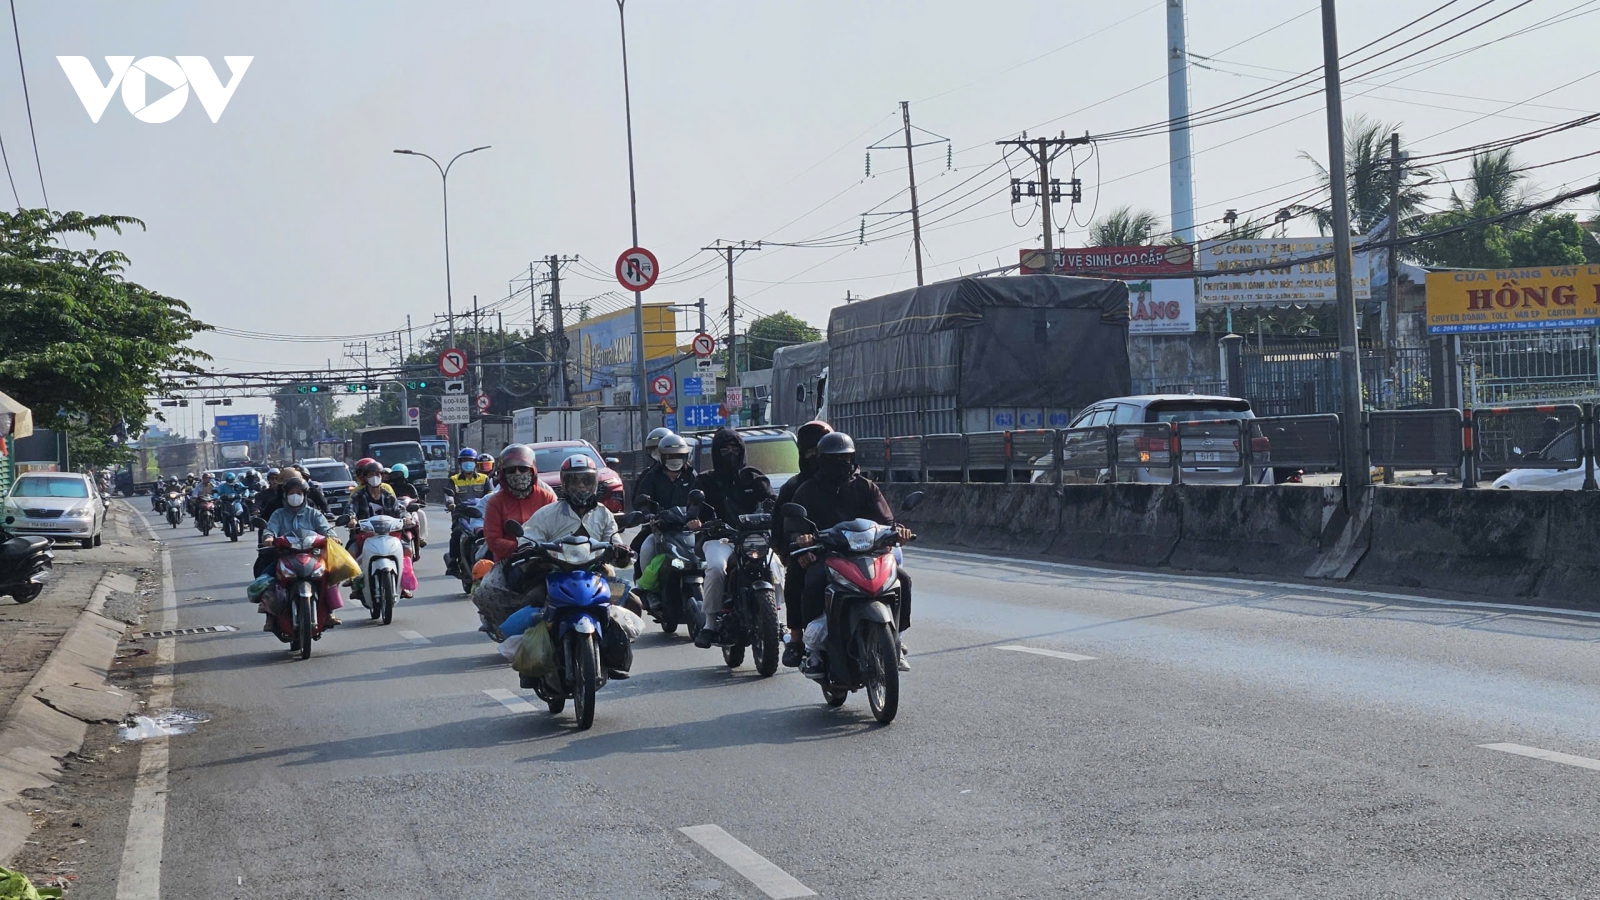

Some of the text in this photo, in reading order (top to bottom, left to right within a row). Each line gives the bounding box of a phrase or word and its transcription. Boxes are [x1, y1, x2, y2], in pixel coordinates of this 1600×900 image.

[1085, 254, 1112, 267] SINH
[1114, 252, 1138, 265] CAO
[1496, 268, 1541, 280] HÀNG
[1466, 279, 1578, 311] HỒNG
[1491, 311, 1508, 319] TOLE
[1547, 308, 1576, 316] CARTON
[727, 393, 740, 401] 900
[995, 413, 1013, 426] 63
[1049, 413, 1068, 426] 09
